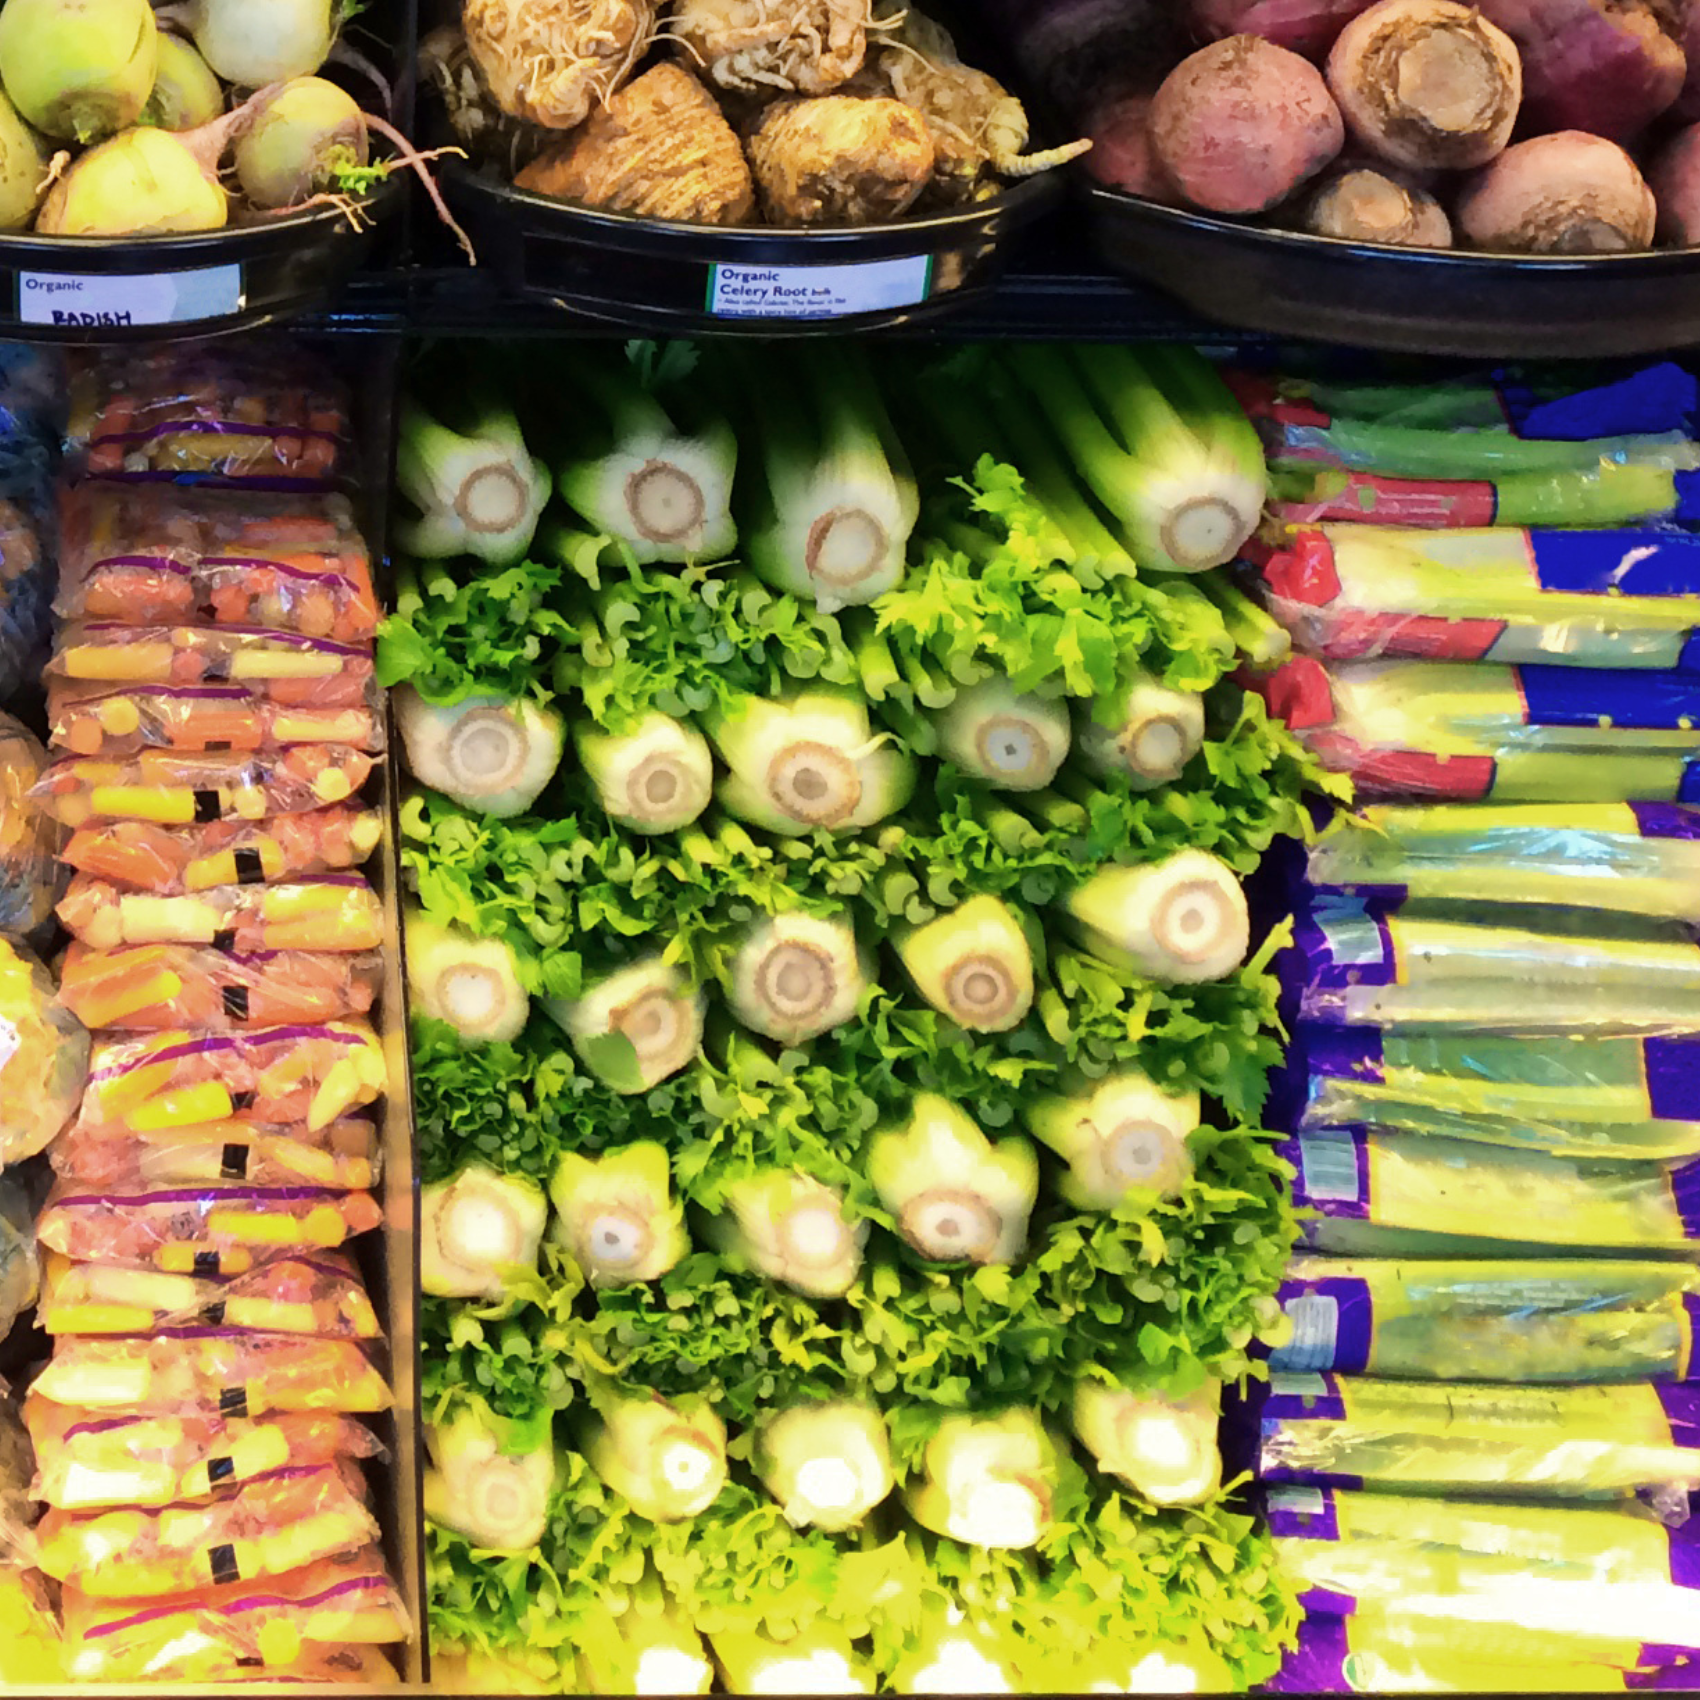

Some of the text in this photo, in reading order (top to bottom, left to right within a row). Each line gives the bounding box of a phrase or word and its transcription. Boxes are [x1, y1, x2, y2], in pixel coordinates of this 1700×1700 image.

[721, 268, 780, 283] Organic
[25, 278, 84, 293] Organic
[720, 284, 768, 299] Celery
[772, 286, 808, 297] Root
[52, 310, 132, 326] RADISH
